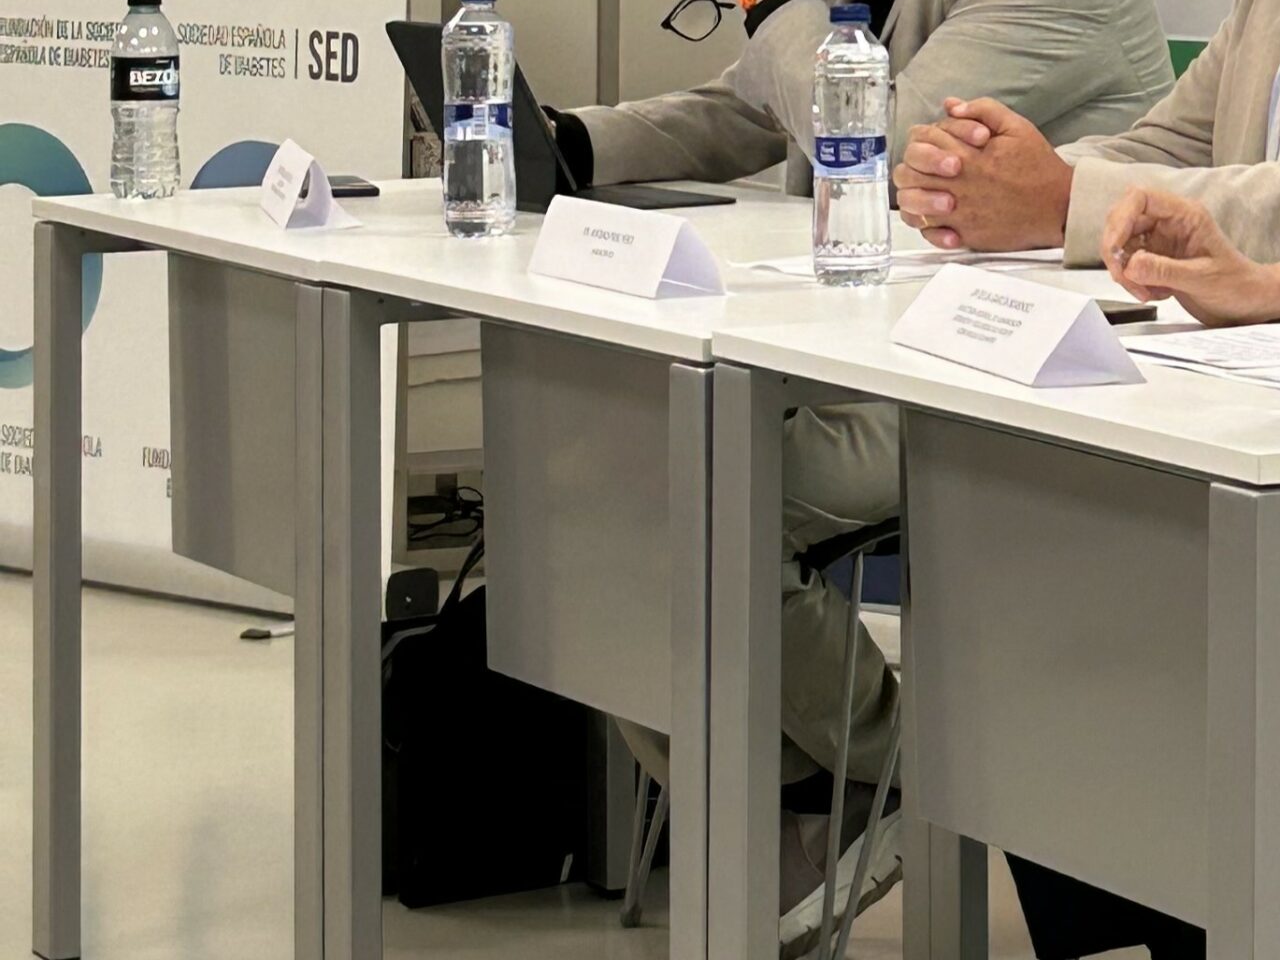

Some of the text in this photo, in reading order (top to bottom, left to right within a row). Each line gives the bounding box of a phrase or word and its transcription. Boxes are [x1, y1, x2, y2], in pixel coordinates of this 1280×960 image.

[72, 21, 83, 40] LA
[219, 54, 232, 75] DE
[308, 30, 360, 83] SED
[130, 70, 178, 86] BEZO
